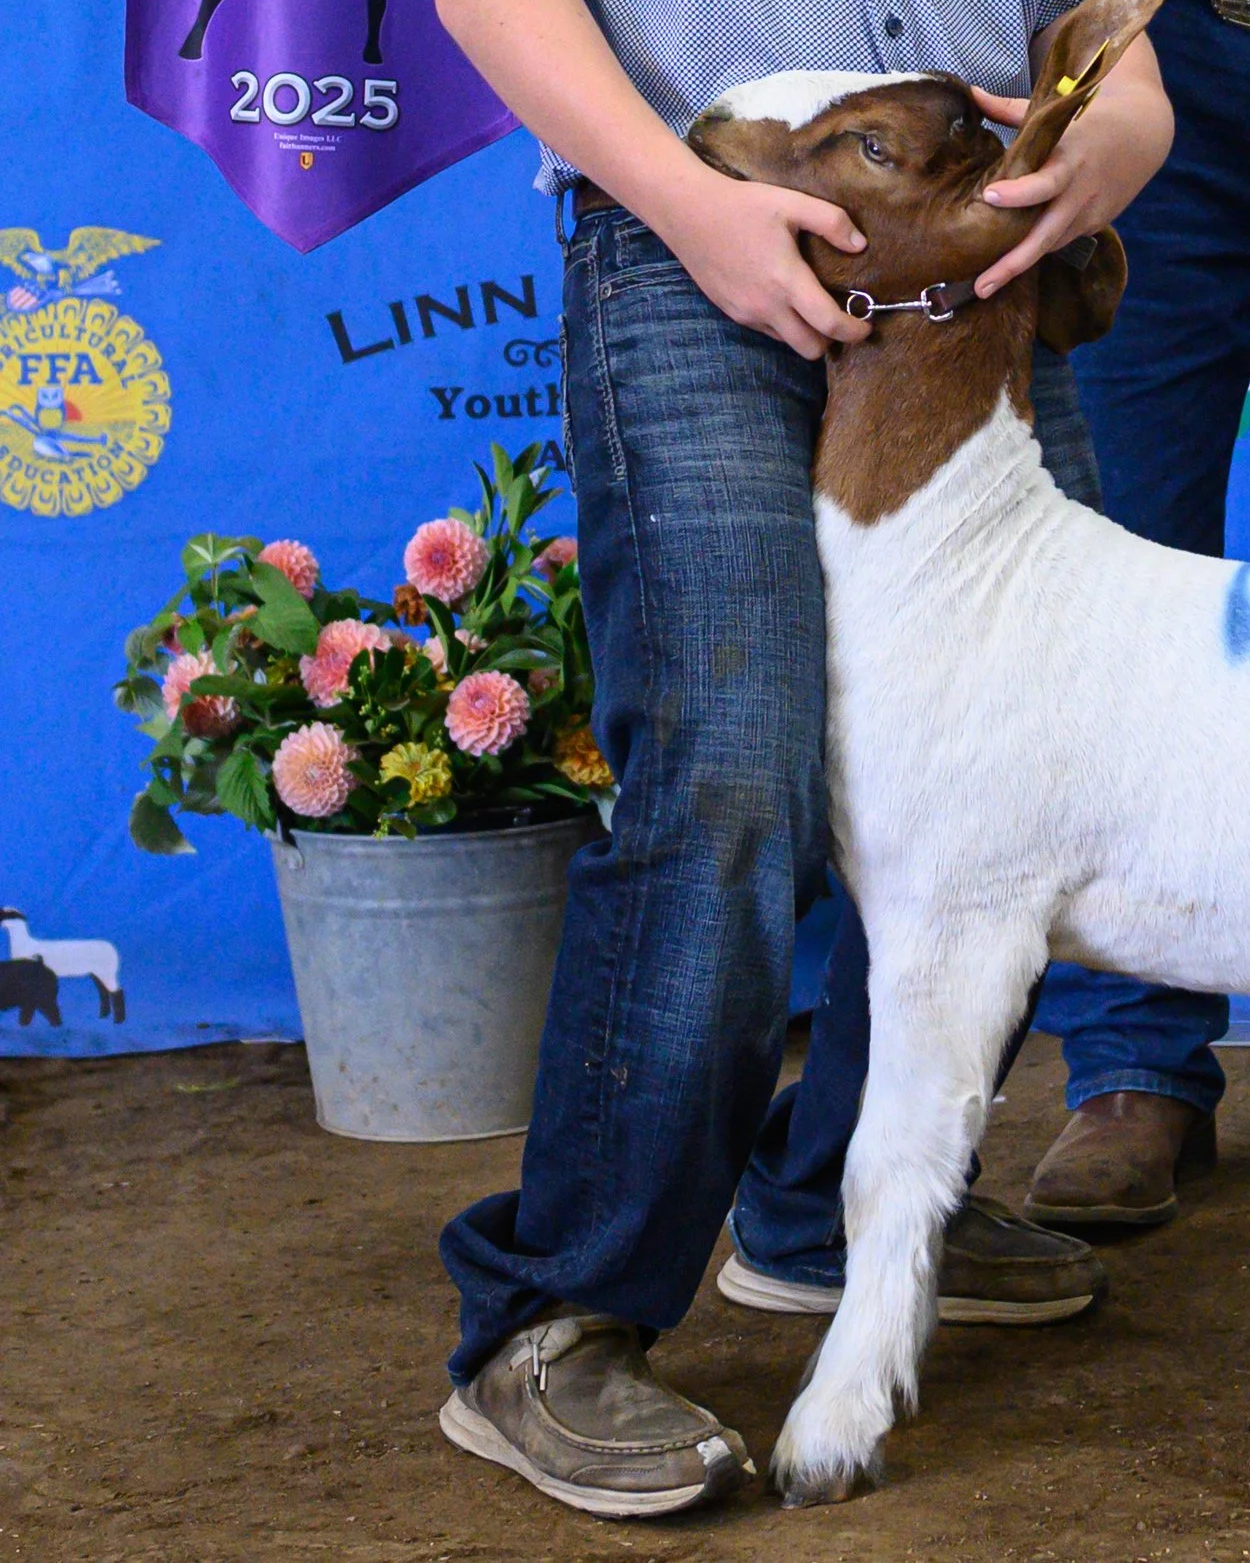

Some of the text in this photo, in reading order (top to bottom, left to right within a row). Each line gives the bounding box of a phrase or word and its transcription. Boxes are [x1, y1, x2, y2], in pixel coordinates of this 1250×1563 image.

[229, 71, 400, 130] 2025
[325, 274, 538, 365] LINN
[0, 323, 136, 390] RICULTURAL
[17, 352, 104, 386] FFA
